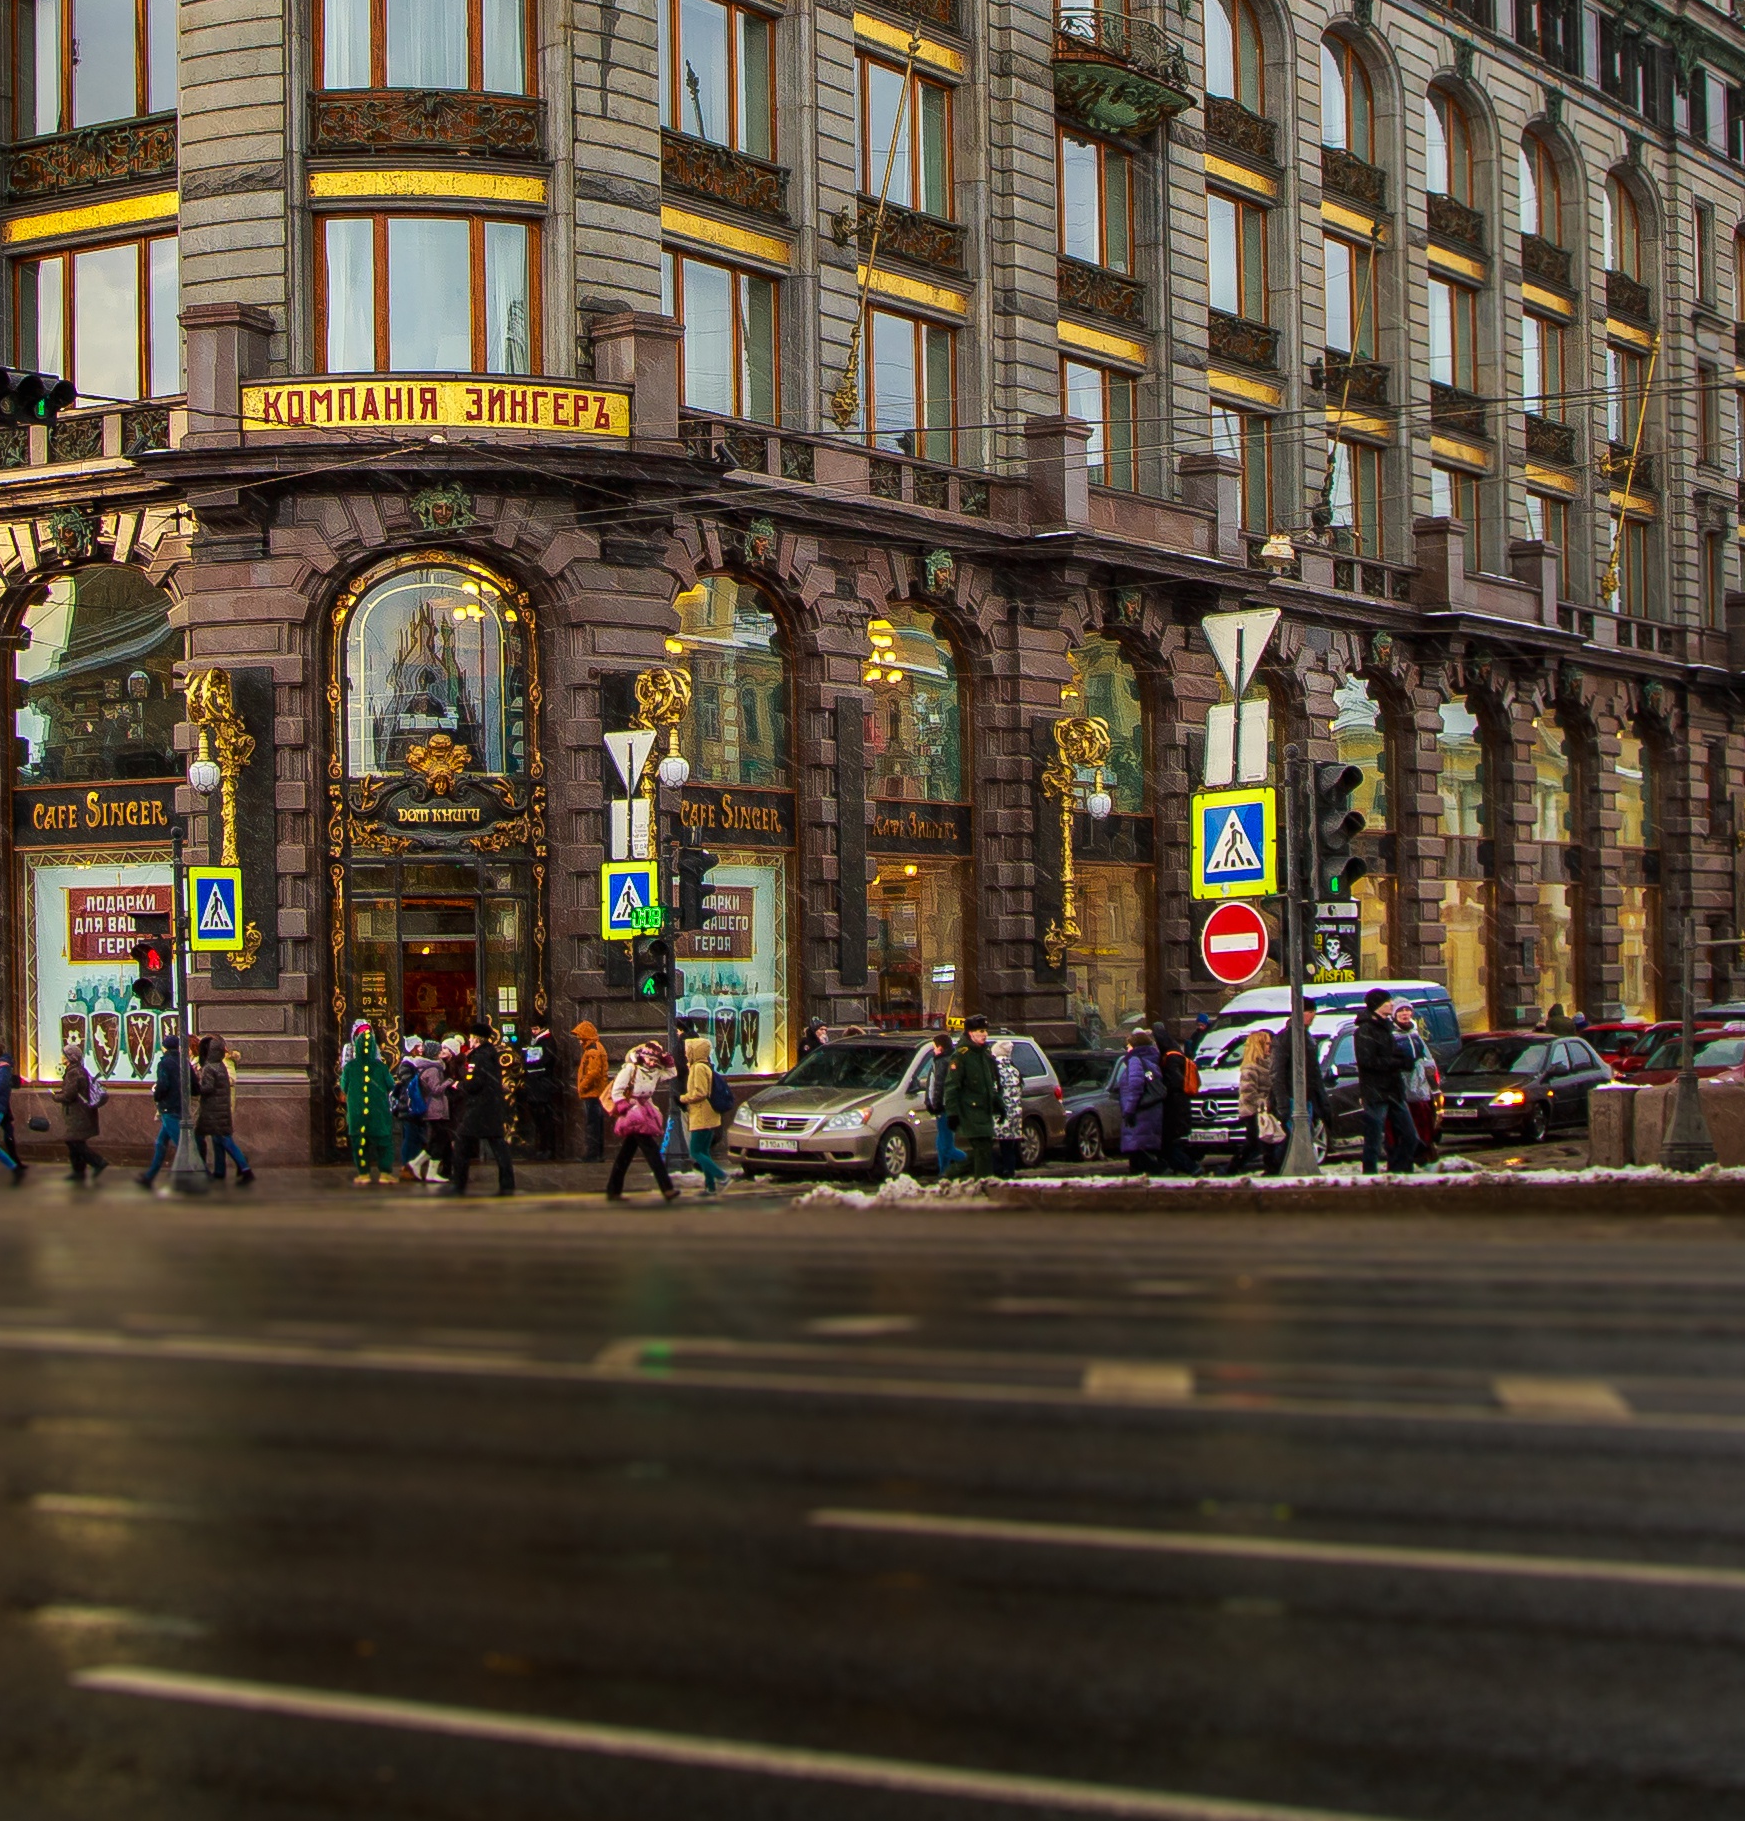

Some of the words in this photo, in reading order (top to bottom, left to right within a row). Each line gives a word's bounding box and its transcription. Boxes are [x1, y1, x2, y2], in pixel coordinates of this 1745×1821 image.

[264, 387, 437, 424] КОМПАНІЯ
[465, 388, 610, 431] ЗИНГЕРЪ
[33, 803, 78, 829] CAFE
[680, 799, 715, 827] CAFE
[86, 894, 155, 913] ПОДАРКИ
[75, 916, 103, 935] ДЛЯ
[695, 936, 731, 951] ГЕРОЯ
